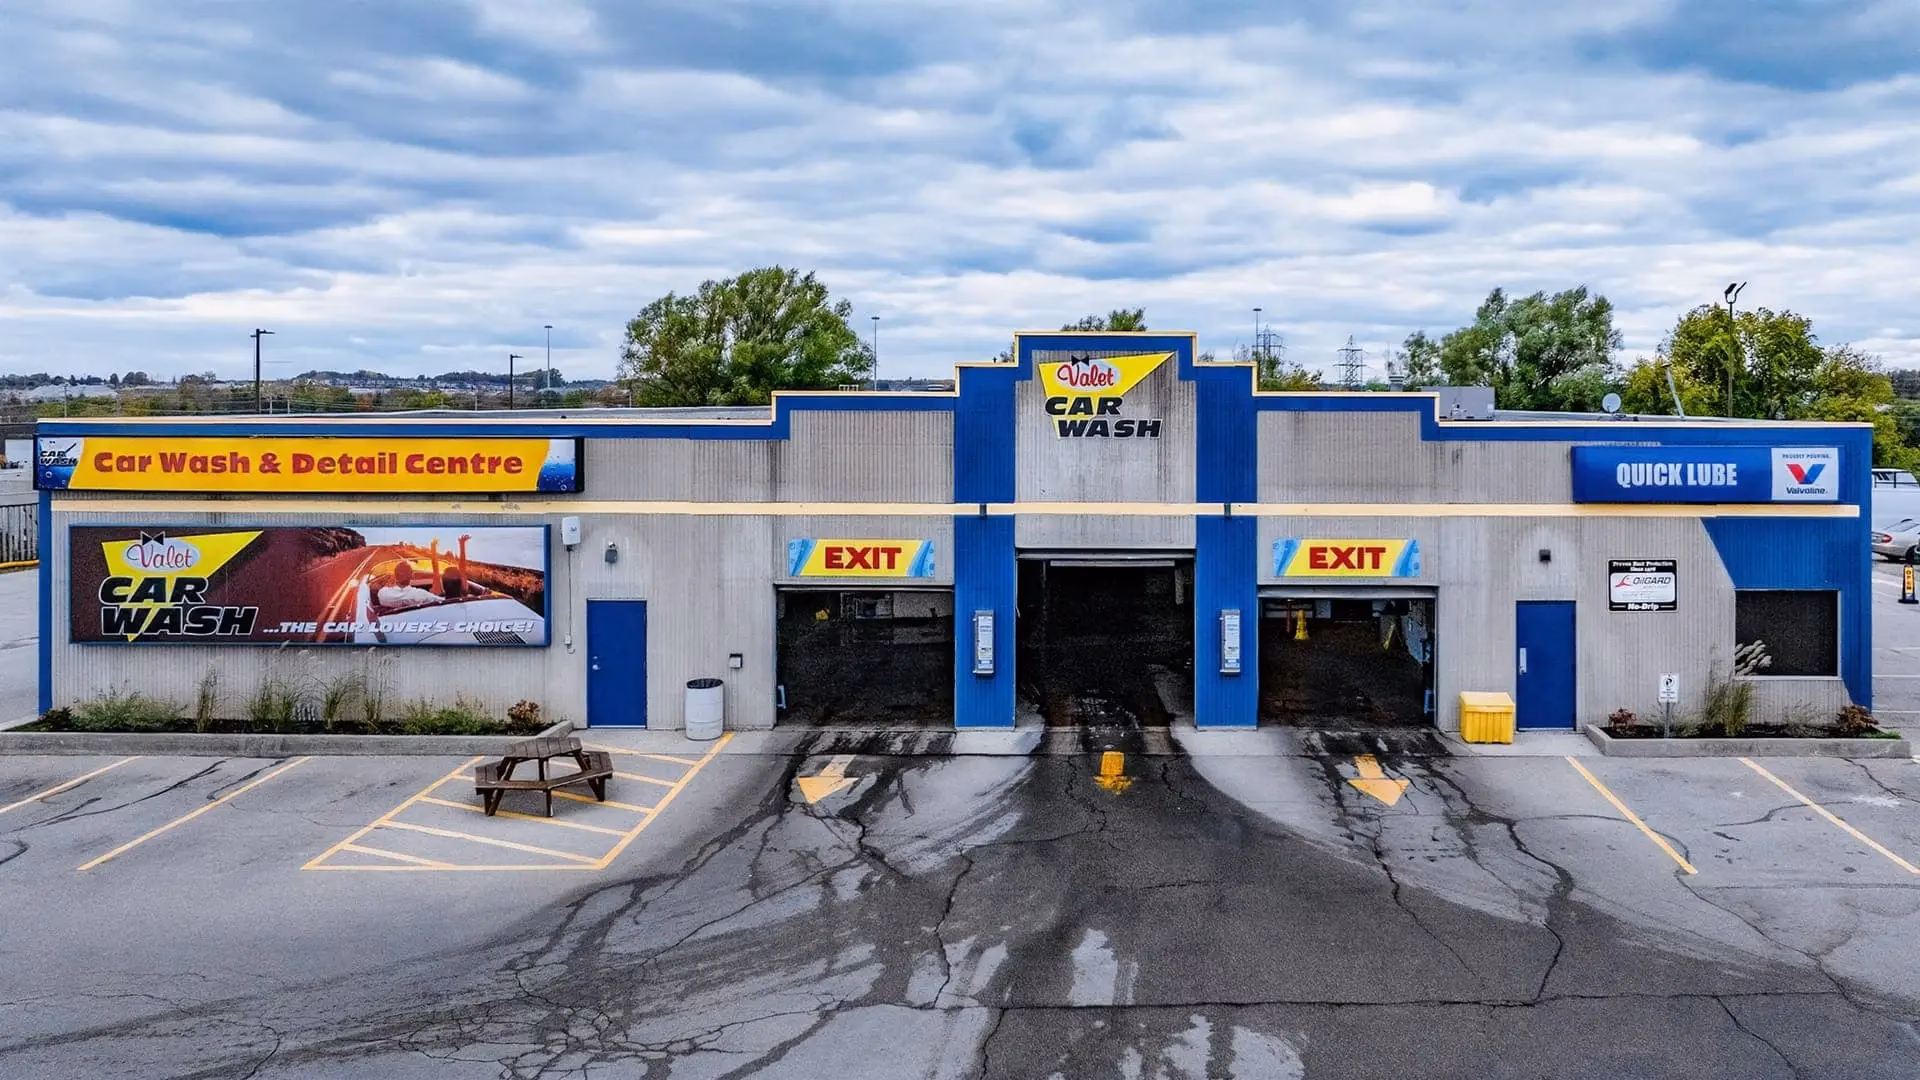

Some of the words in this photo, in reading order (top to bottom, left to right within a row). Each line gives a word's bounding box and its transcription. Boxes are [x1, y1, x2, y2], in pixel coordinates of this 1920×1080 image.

[1057, 364, 1115, 387] Valet
[1044, 396, 1124, 416] CAR
[1057, 419, 1162, 438] WASH
[94, 452, 152, 473] Car
[159, 452, 250, 473] Wash
[258, 453, 281, 474] &
[291, 452, 397, 474] Detail
[405, 453, 523, 474] Centre
[1616, 463, 1683, 488] QUICK
[1687, 463, 1738, 486] LUBE
[1786, 487, 1826, 495] Valvoline
[127, 543, 193, 568] Valet
[825, 546, 902, 570] EXIT
[1309, 546, 1386, 570] EXIT
[99, 576, 208, 605] CAR
[1627, 603, 1660, 611] No-Drip
[101, 606, 259, 636] WASH
[263, 622, 317, 634] ...THE
[323, 622, 364, 634] CAR
[368, 621, 451, 634] LOVER'S
[455, 621, 535, 634] CHOICE!
